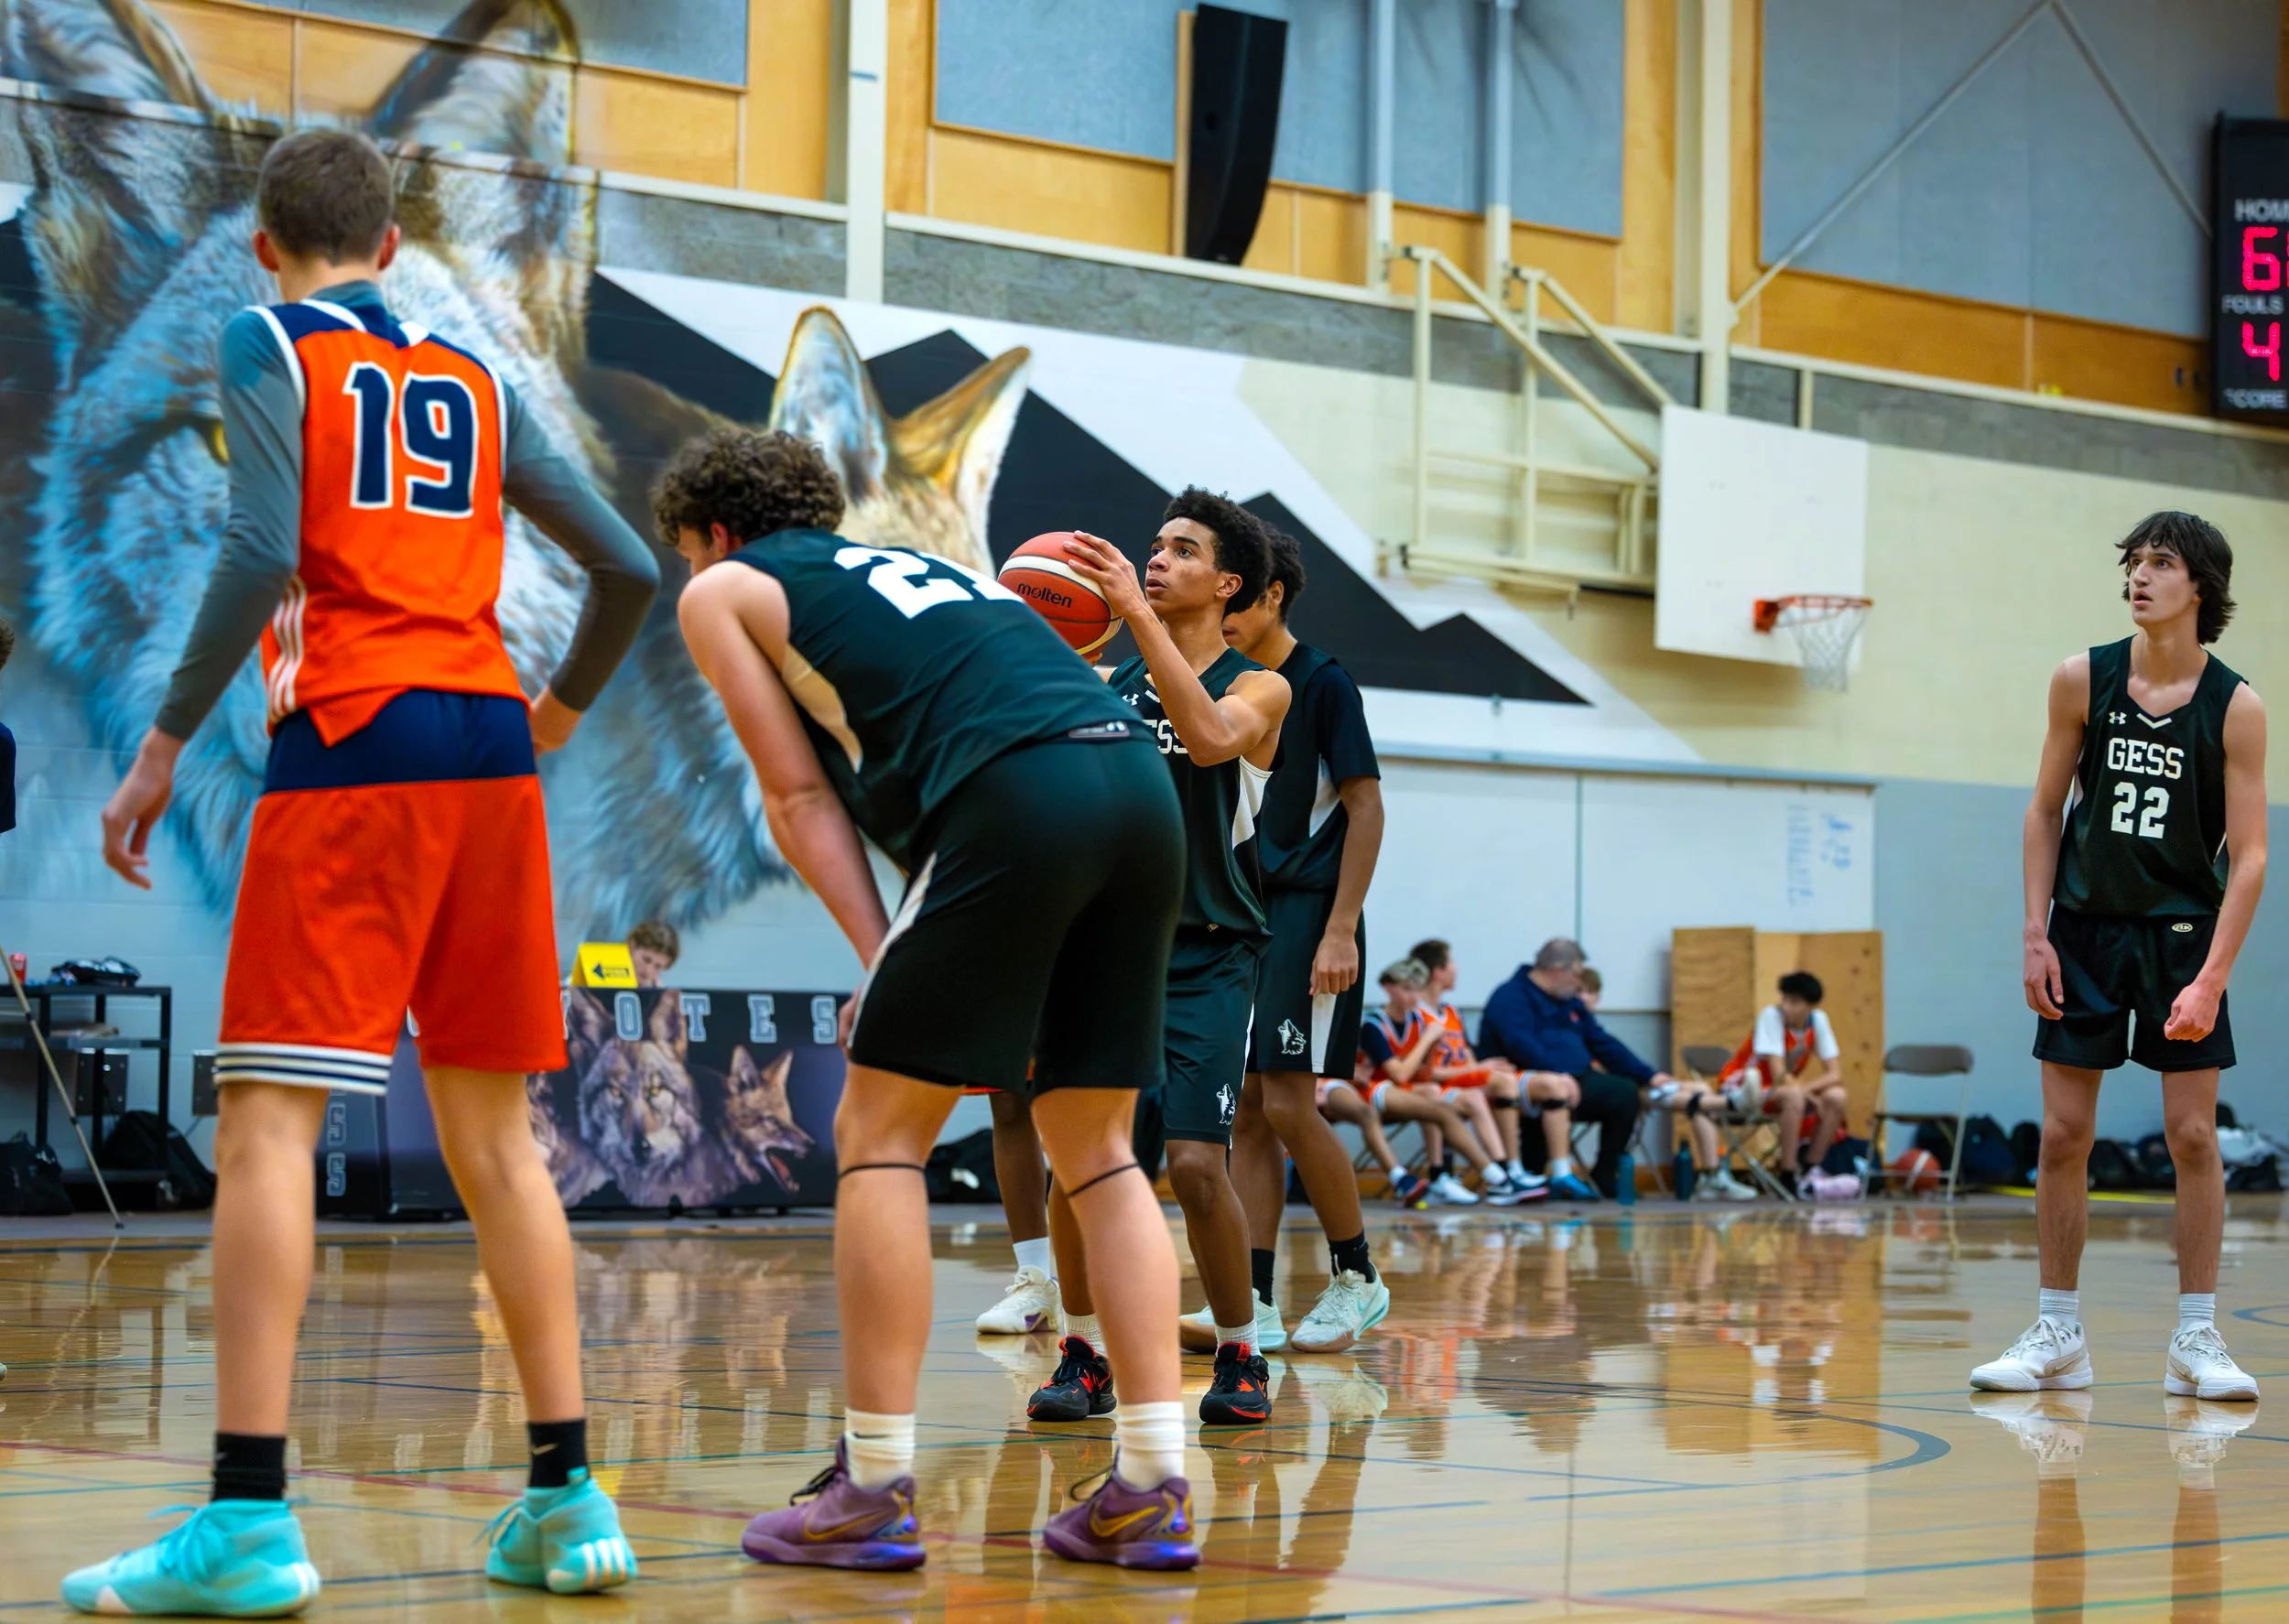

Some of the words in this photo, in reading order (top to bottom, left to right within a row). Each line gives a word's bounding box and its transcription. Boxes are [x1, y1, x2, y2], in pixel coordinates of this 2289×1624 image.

[2242, 226, 2289, 291] 6
[2222, 295, 2284, 315] FOULS
[2242, 322, 2280, 382] 4
[342, 361, 479, 519] 19
[1017, 583, 1072, 608] molten
[2107, 737, 2185, 780] GESS
[2110, 781, 2170, 839] 22
[560, 991, 838, 1044] OTES
